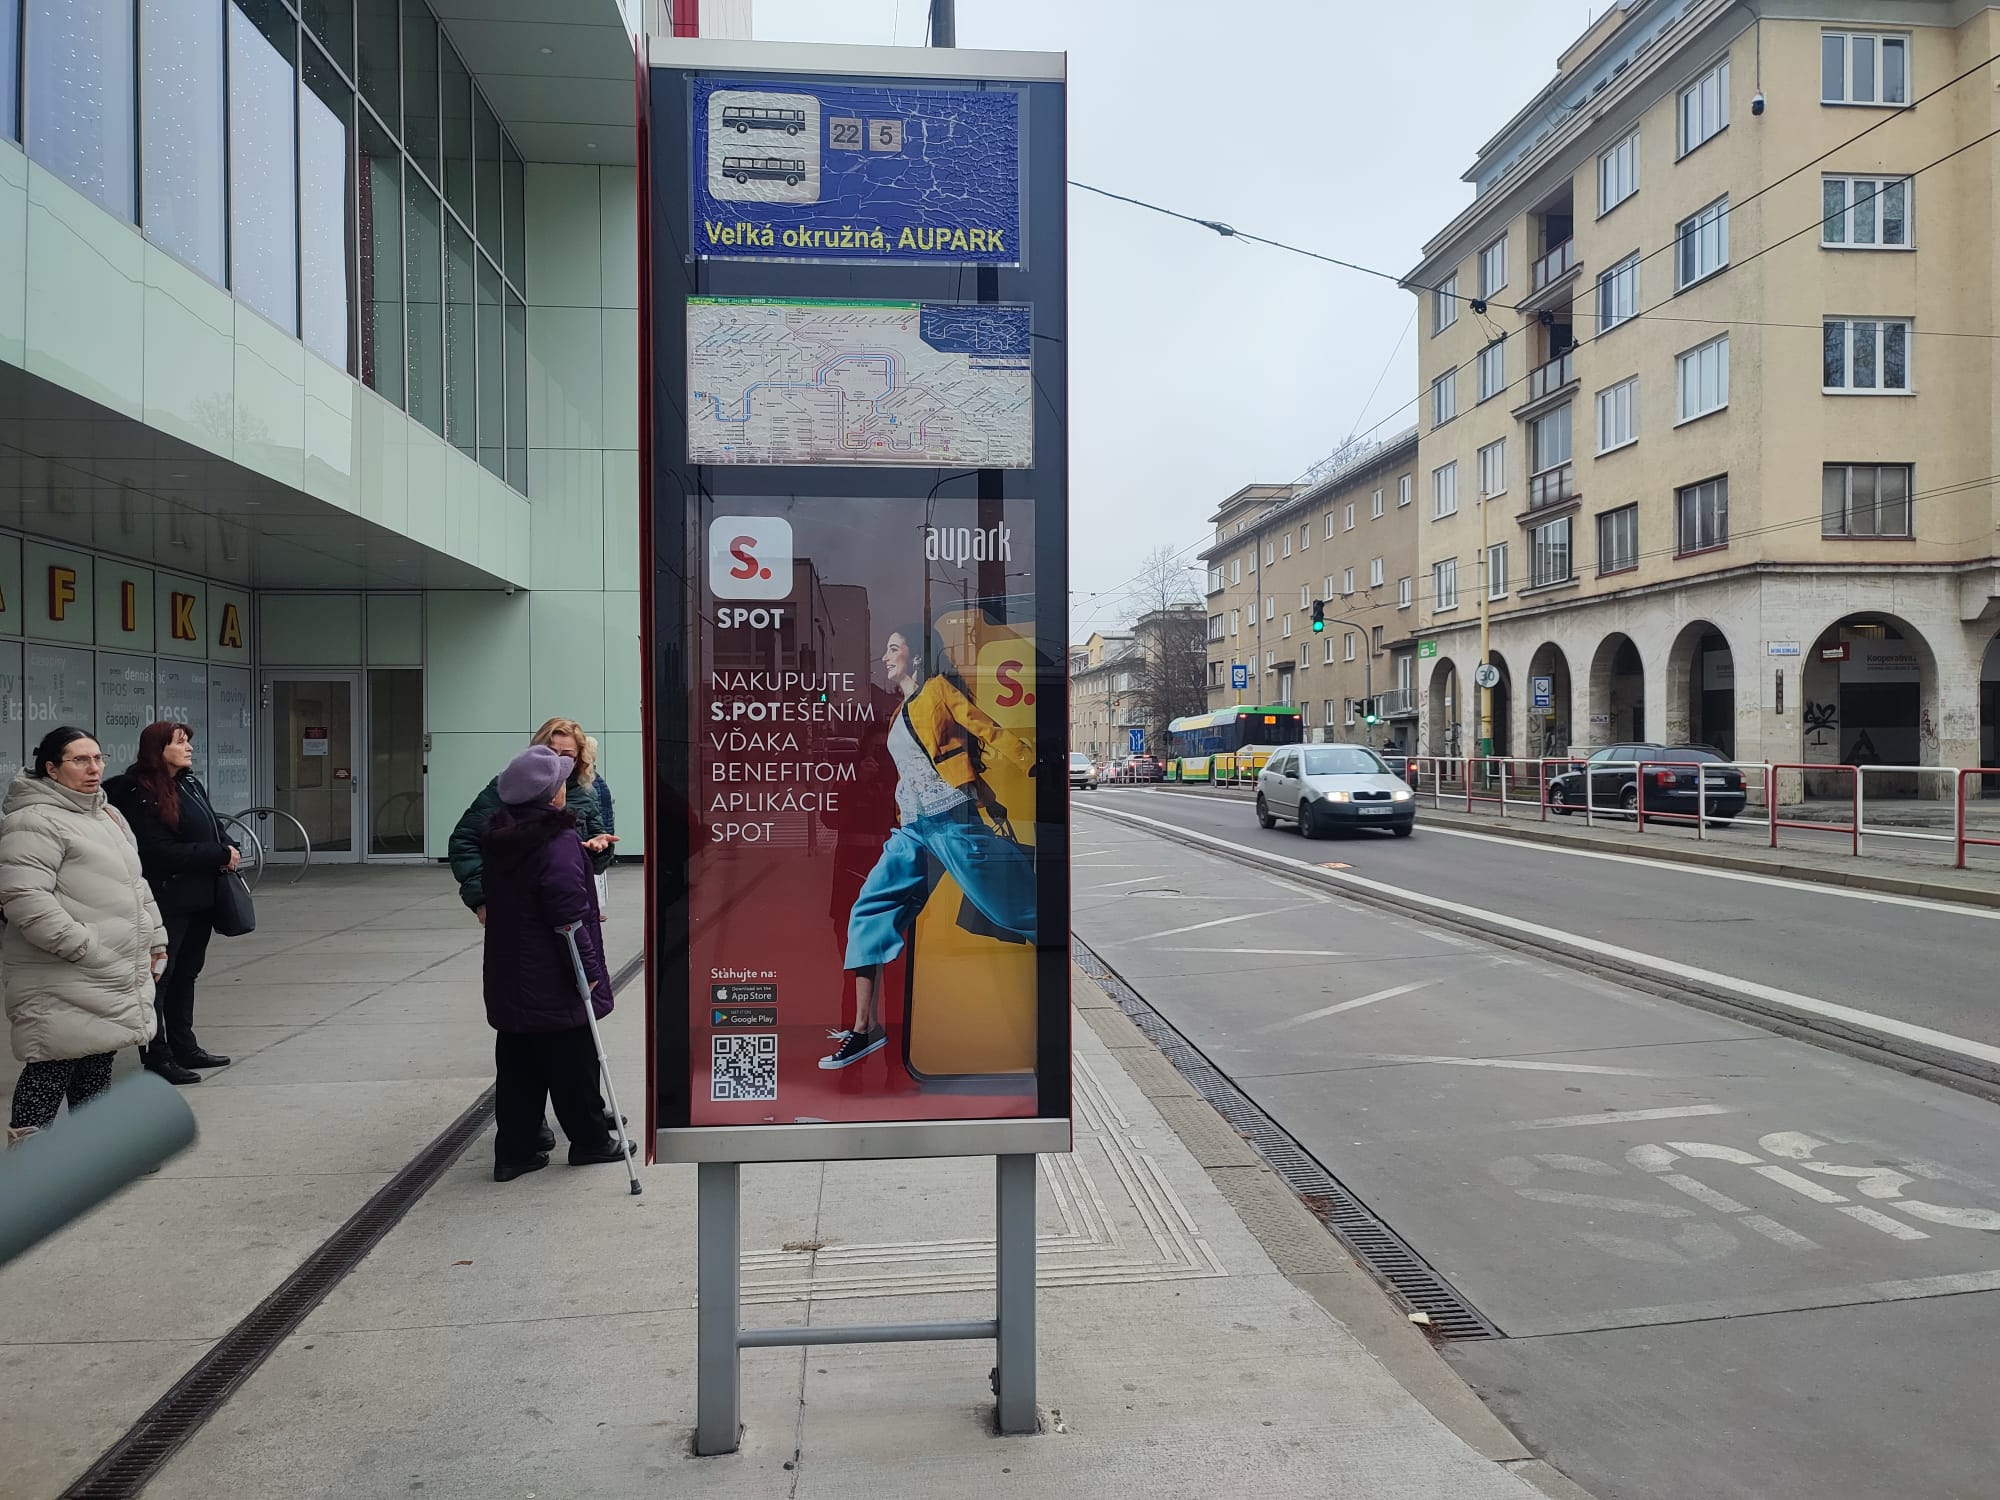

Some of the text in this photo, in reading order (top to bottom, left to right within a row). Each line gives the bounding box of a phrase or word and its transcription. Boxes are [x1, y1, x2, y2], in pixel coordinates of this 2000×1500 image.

[833, 124, 893, 146] 22 5
[704, 221, 1005, 253] Veľká okružná, AUPARK
[925, 521, 1012, 568] aupark
[729, 535, 772, 580] S.
[0, 566, 243, 648] FIKA
[717, 608, 785, 629] SPOT
[711, 671, 856, 692] NAKUPUJTE
[996, 660, 1036, 707] S.
[1480, 670, 1495, 681] 30
[710, 697, 876, 722] S.POTEŠENÍM
[710, 728, 800, 752] VĎAKA
[711, 762, 857, 782] BENEFITOM
[710, 788, 840, 812] APLIKÁCIE
[710, 822, 775, 843] SPOT
[760, 970, 777, 978] na:
[731, 991, 772, 1002] App Store
[730, 1015, 774, 1024] Google Play
